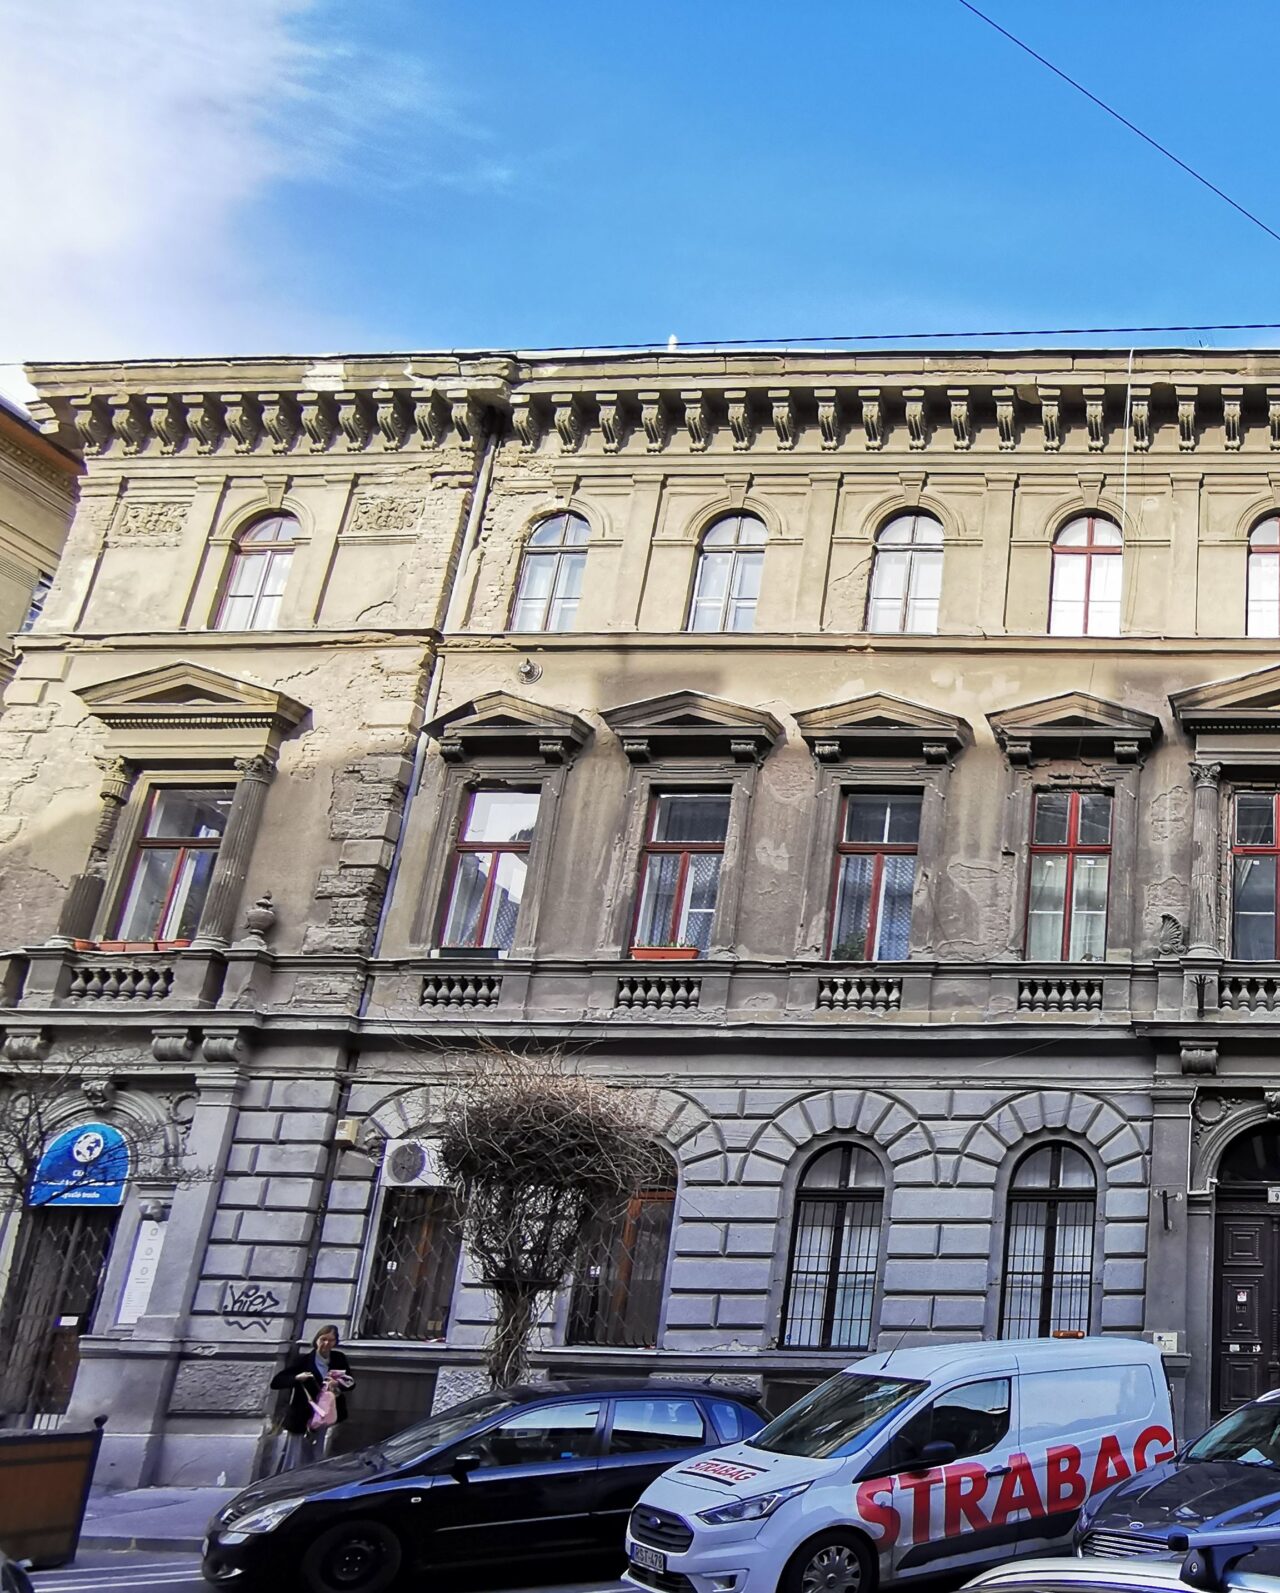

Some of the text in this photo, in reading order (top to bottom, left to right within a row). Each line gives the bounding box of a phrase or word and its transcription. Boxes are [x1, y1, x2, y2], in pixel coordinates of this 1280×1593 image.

[1274, 1192, 1280, 1201] 9
[687, 1461, 757, 1481] STRABAG
[856, 1425, 1175, 1550] STRABAG
